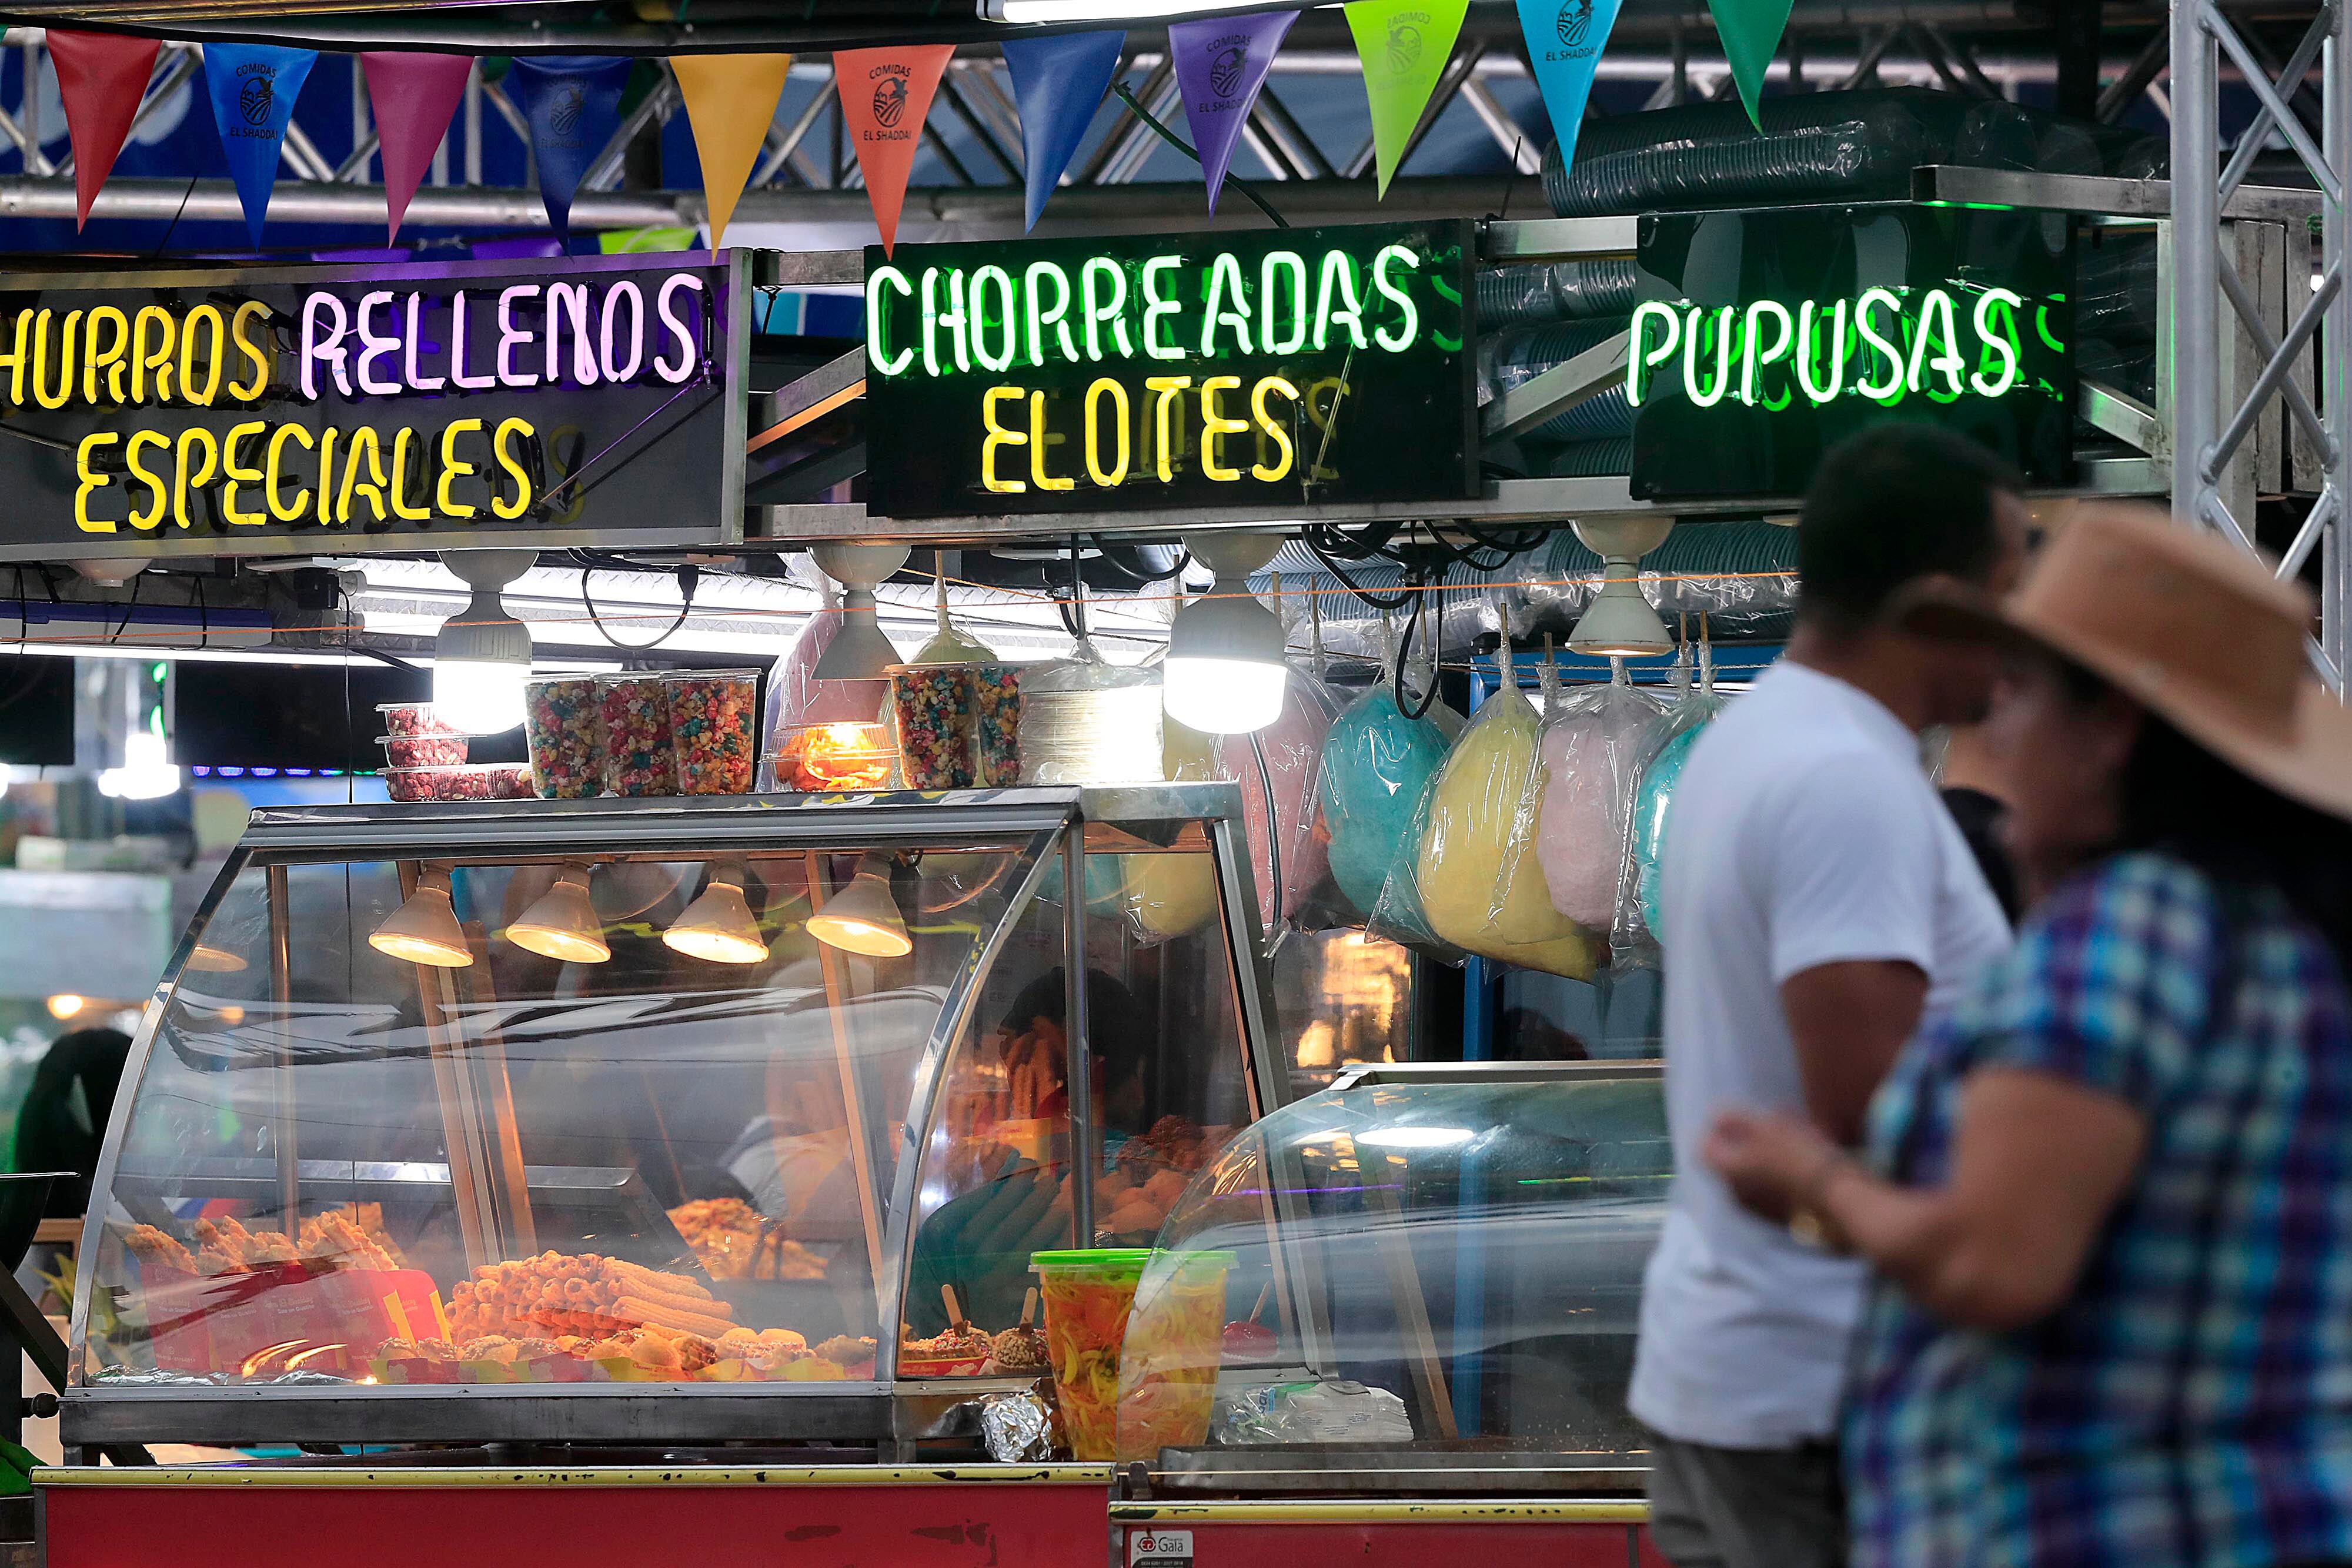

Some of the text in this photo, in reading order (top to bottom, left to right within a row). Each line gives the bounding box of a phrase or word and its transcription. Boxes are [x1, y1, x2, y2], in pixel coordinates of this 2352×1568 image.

[1207, 35, 1252, 52] COMIDAS
[1545, 51, 1557, 62] EL
[236, 63, 277, 78] COMIDAS
[869, 65, 911, 79] COMIDAS
[1199, 103, 1210, 113] EL
[230, 126, 278, 140] EL SHADDAI
[863, 130, 911, 141] EL SHADDAI
[866, 245, 1420, 376] CHORREADAS
[300, 273, 703, 401] RELLENOS
[1626, 287, 2022, 407] PUPUSAS
[982, 376, 1300, 493] ELOTES
[74, 416, 534, 534] ESPECIALES
[1158, 1537, 1183, 1552] Gala
